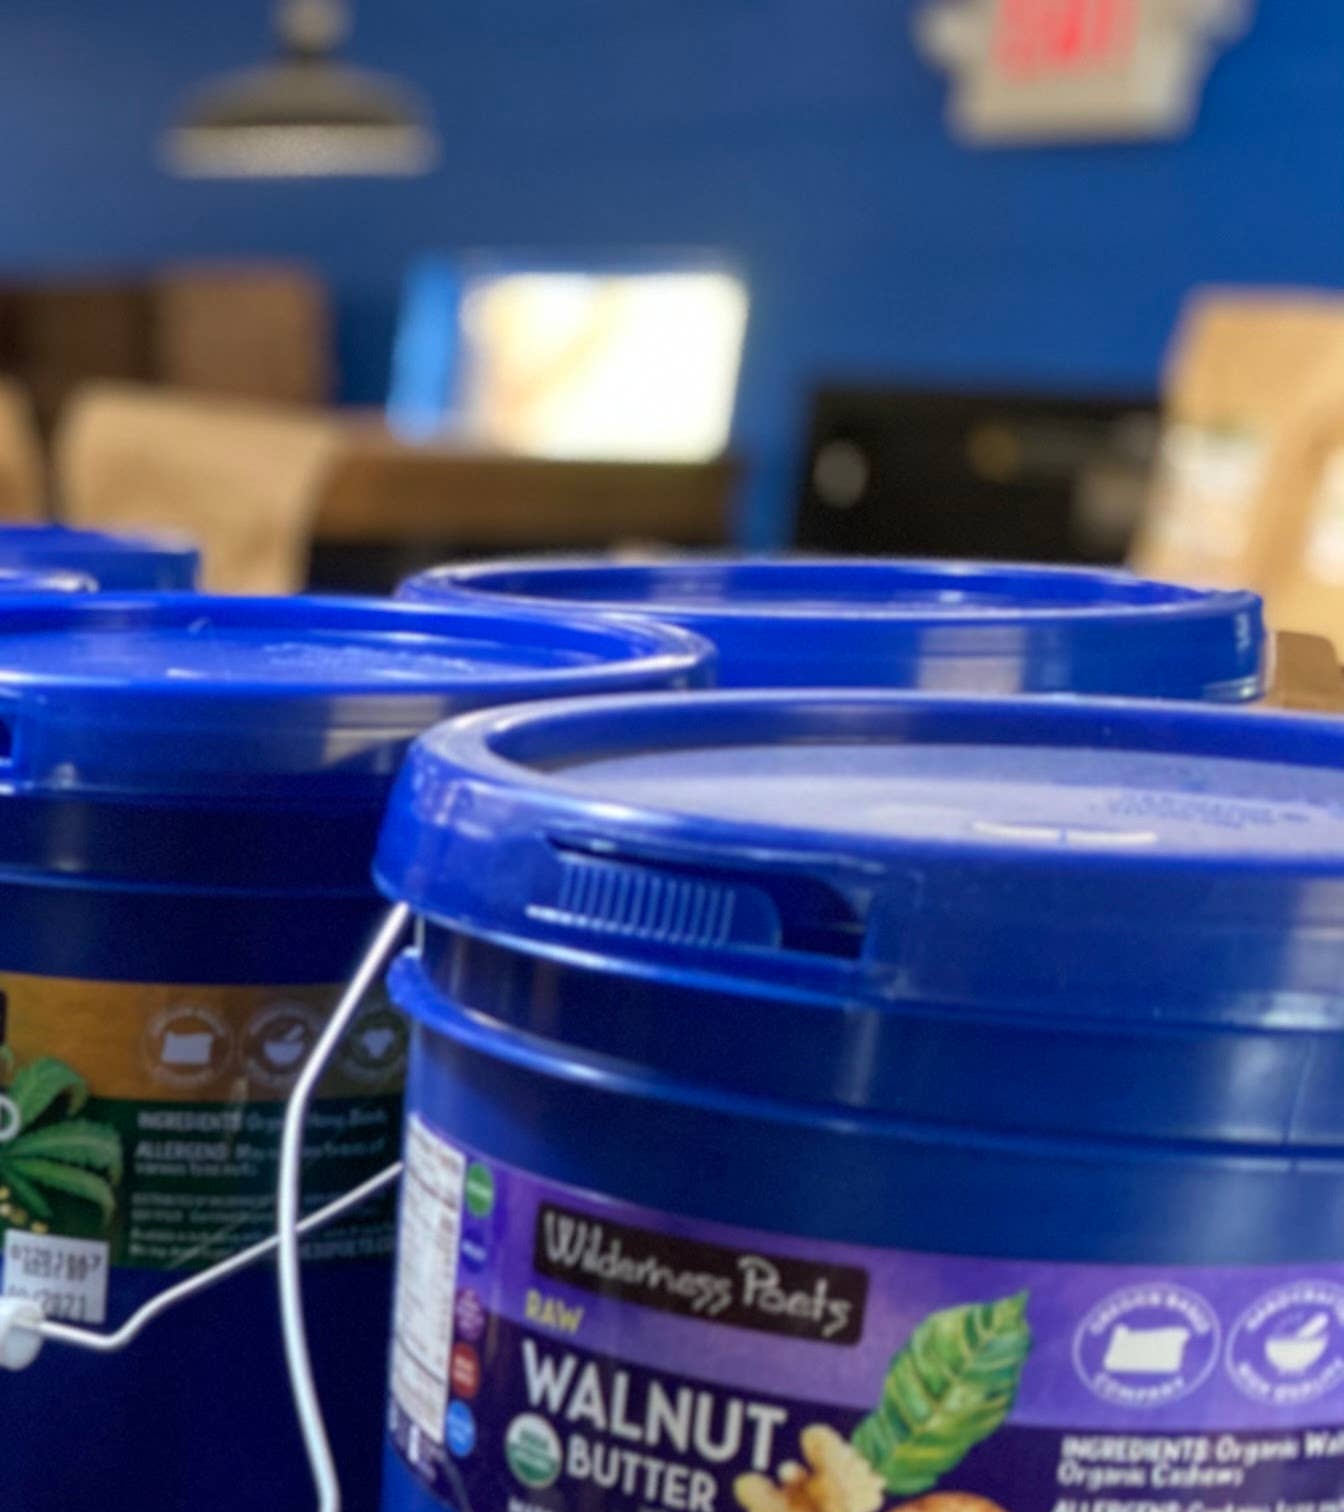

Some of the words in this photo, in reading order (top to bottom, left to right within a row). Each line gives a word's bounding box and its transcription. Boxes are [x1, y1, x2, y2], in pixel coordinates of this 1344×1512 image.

[542, 1210, 733, 1317] Wilderness
[736, 1254, 853, 1338] Poets
[523, 1289, 585, 1335] RAW
[522, 1338, 789, 1471] WALNUT
[1215, 1432, 1300, 1464] Organic
[1057, 1458, 1146, 1491] Organic
